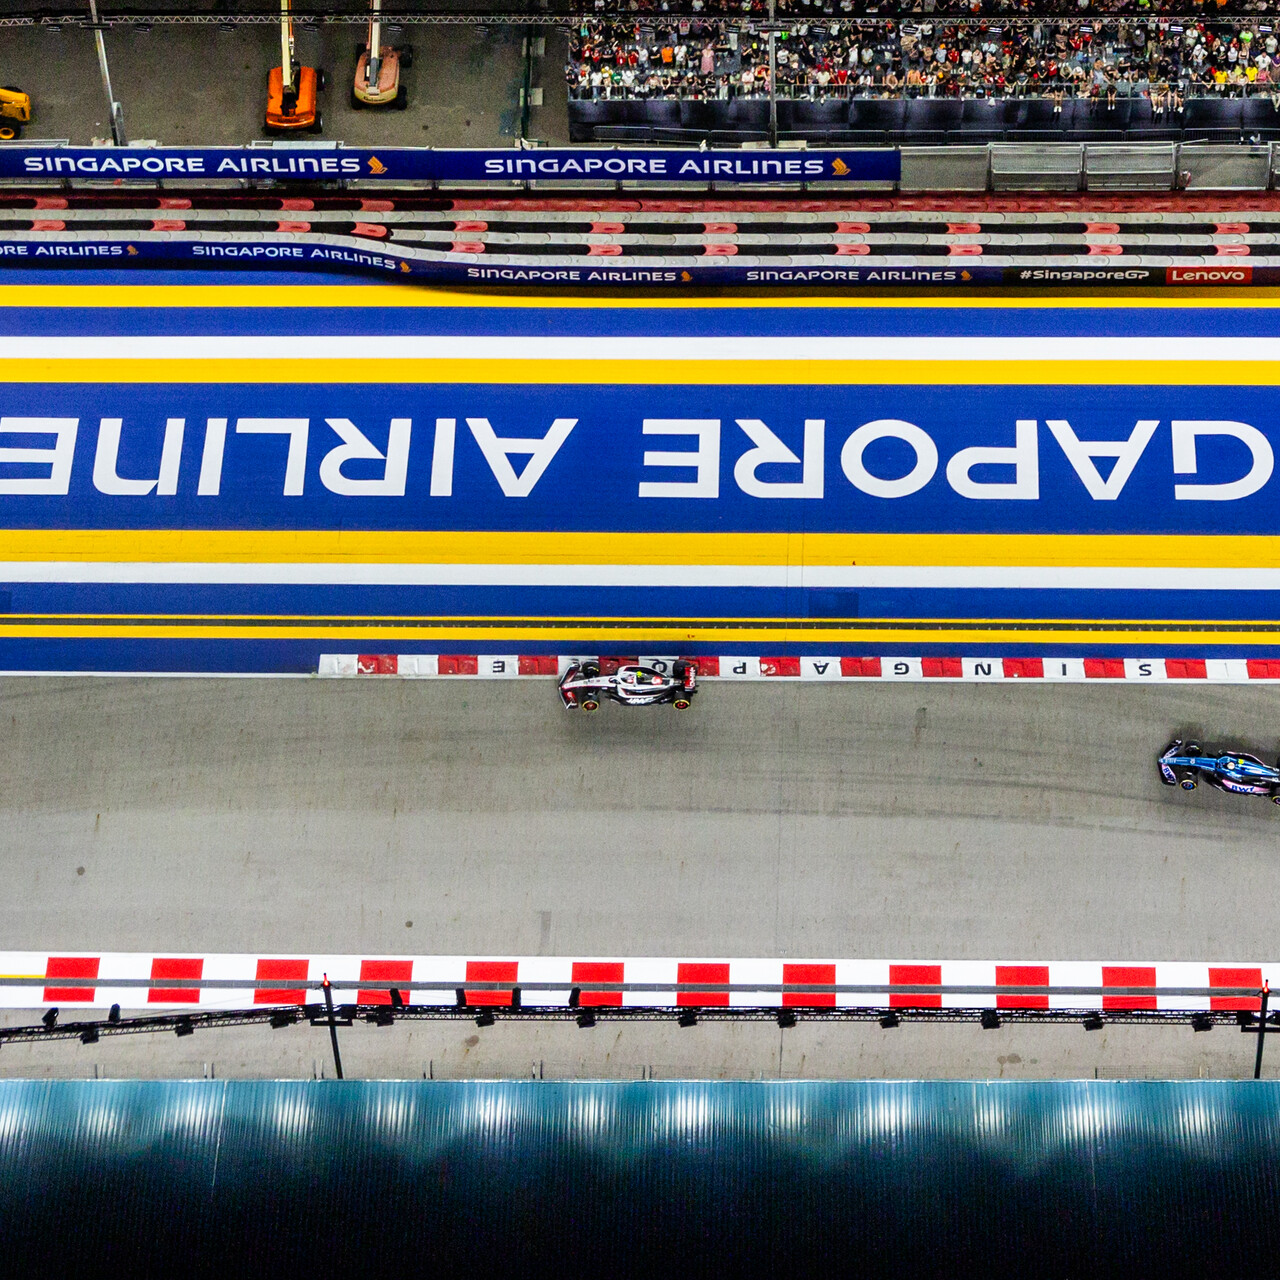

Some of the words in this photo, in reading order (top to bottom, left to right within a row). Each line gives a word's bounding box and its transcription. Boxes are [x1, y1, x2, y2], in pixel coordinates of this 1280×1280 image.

[24, 157, 205, 173] SINGAPORE
[217, 157, 361, 173] AIRLINES
[484, 159, 667, 173] SINGAPORE
[679, 159, 824, 175] AIRLINES
[35, 245, 123, 256] AIRLINES
[192, 245, 304, 258] SINGAPORE
[310, 248, 396, 270] AIRLINES
[467, 268, 580, 281] SINGAPORE
[587, 271, 676, 282] AIRLINES
[746, 270, 859, 281] SINGAPORE
[867, 271, 957, 281] AIRLINES
[1020, 270, 1150, 280] #SingaporeGP
[1172, 270, 1245, 281] Lenovo
